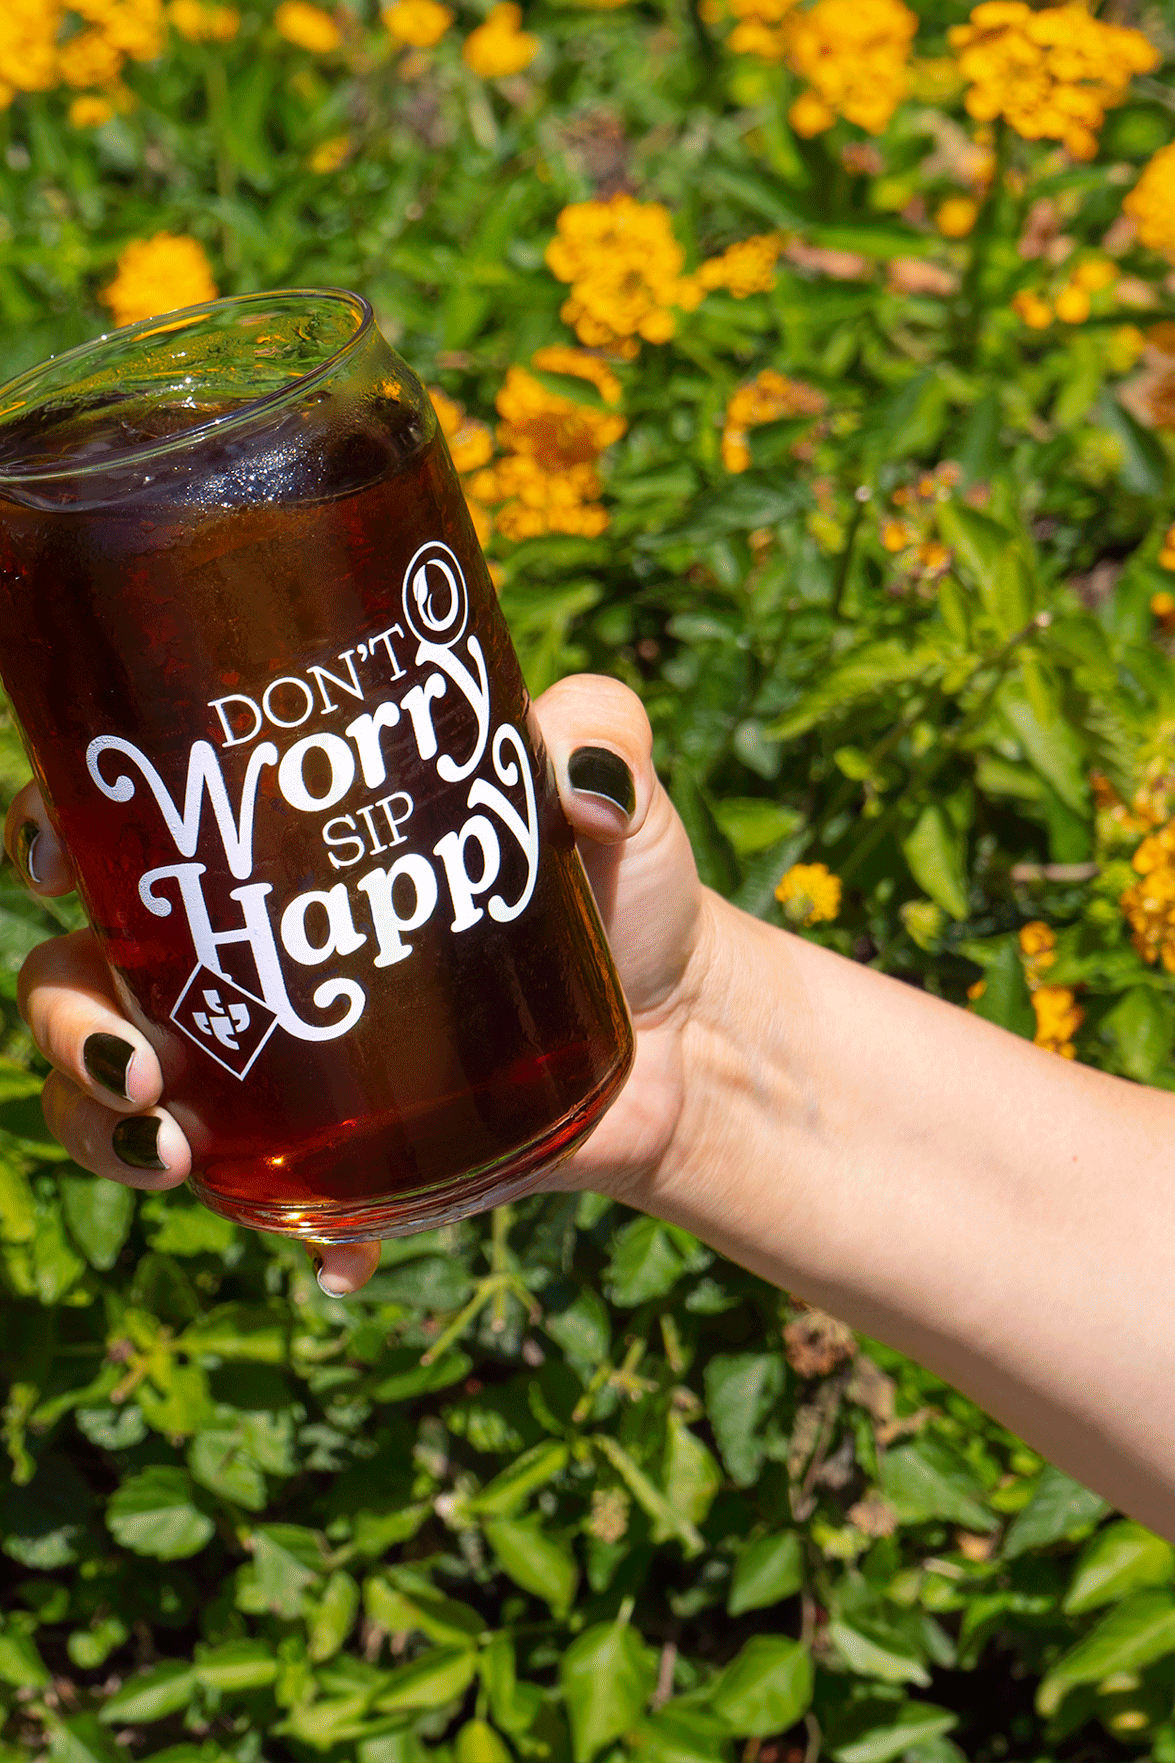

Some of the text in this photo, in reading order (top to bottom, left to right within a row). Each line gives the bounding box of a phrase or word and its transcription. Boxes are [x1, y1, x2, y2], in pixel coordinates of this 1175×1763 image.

[85, 635, 491, 880] Worry
[207, 623, 408, 748] DON'T
[138, 723, 539, 1041] Happy
[321, 791, 414, 869] SIP
